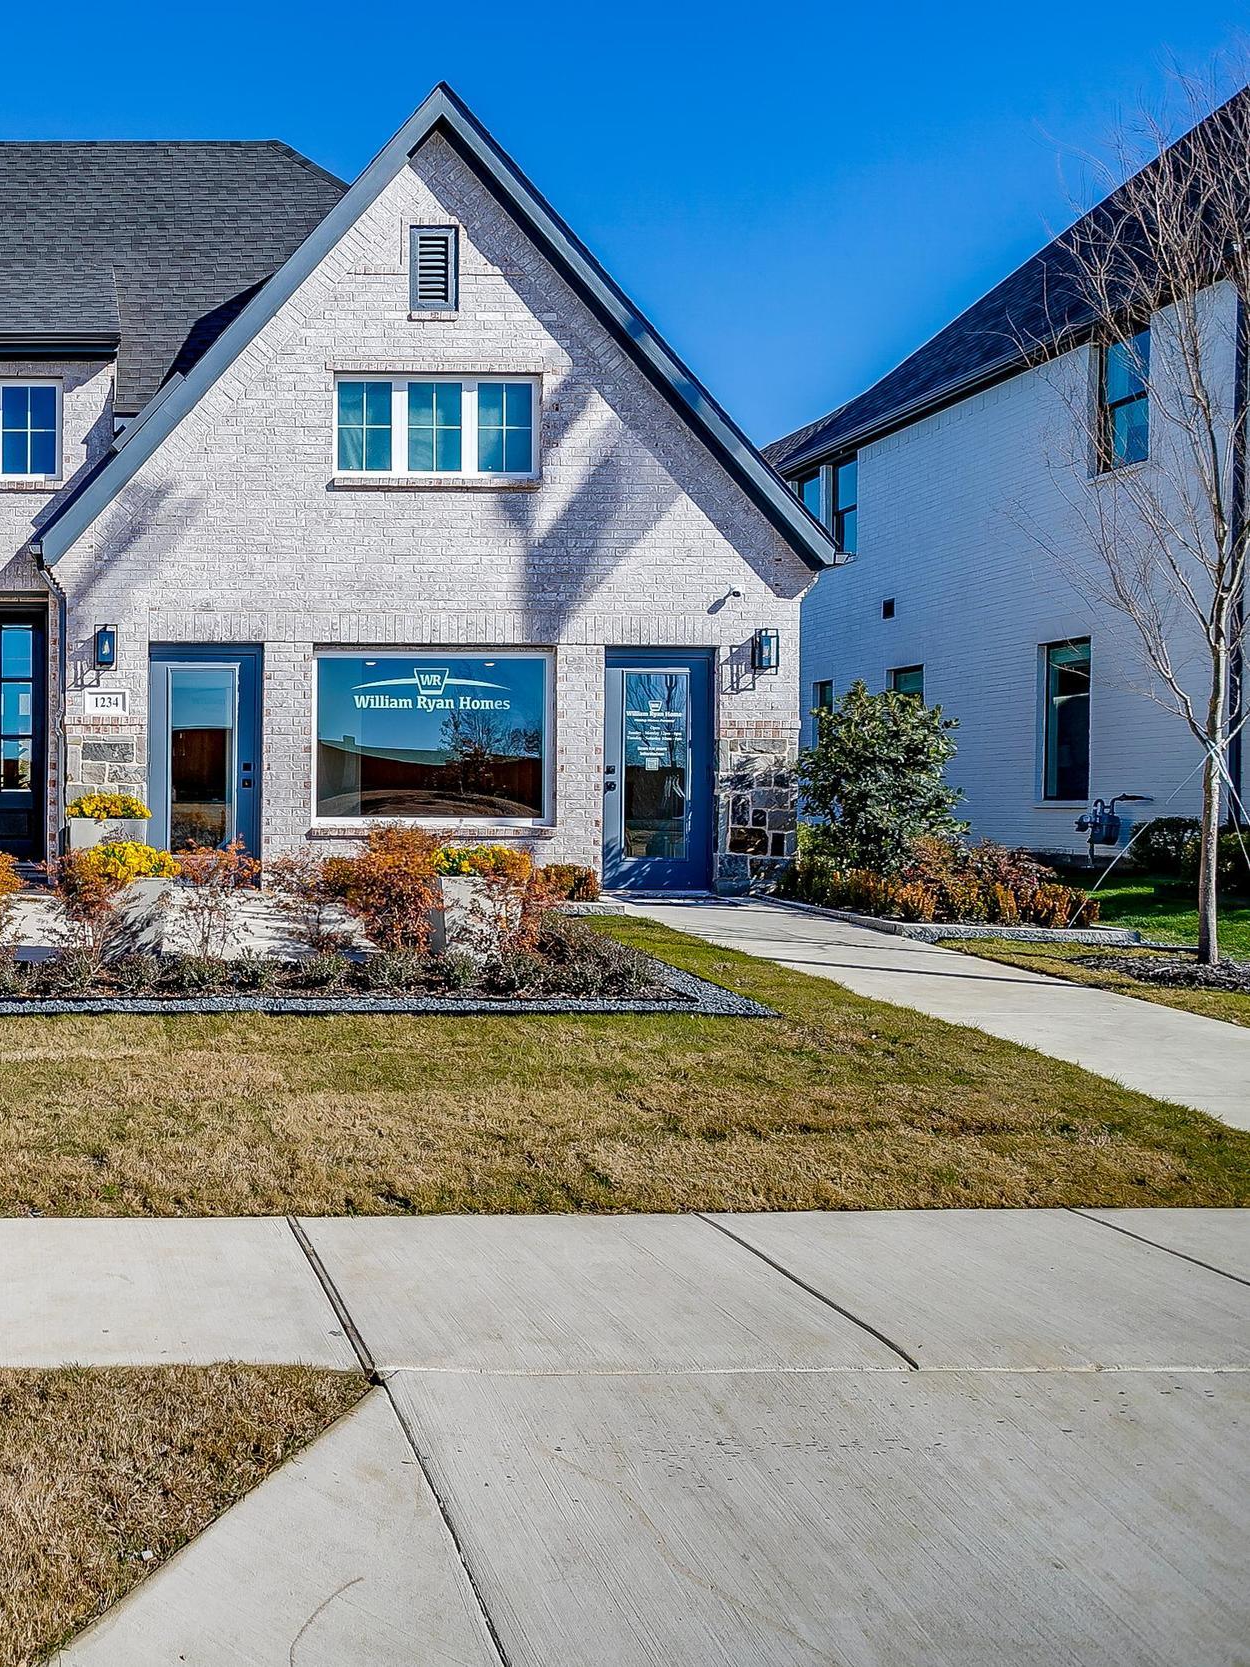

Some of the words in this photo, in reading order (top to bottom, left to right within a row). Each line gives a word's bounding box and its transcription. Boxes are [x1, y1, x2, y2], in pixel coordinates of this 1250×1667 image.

[420, 674, 441, 686] WR
[94, 696, 119, 708] 1234
[353, 694, 413, 710] William
[416, 695, 455, 713] Ryan
[459, 696, 511, 710] Homes
